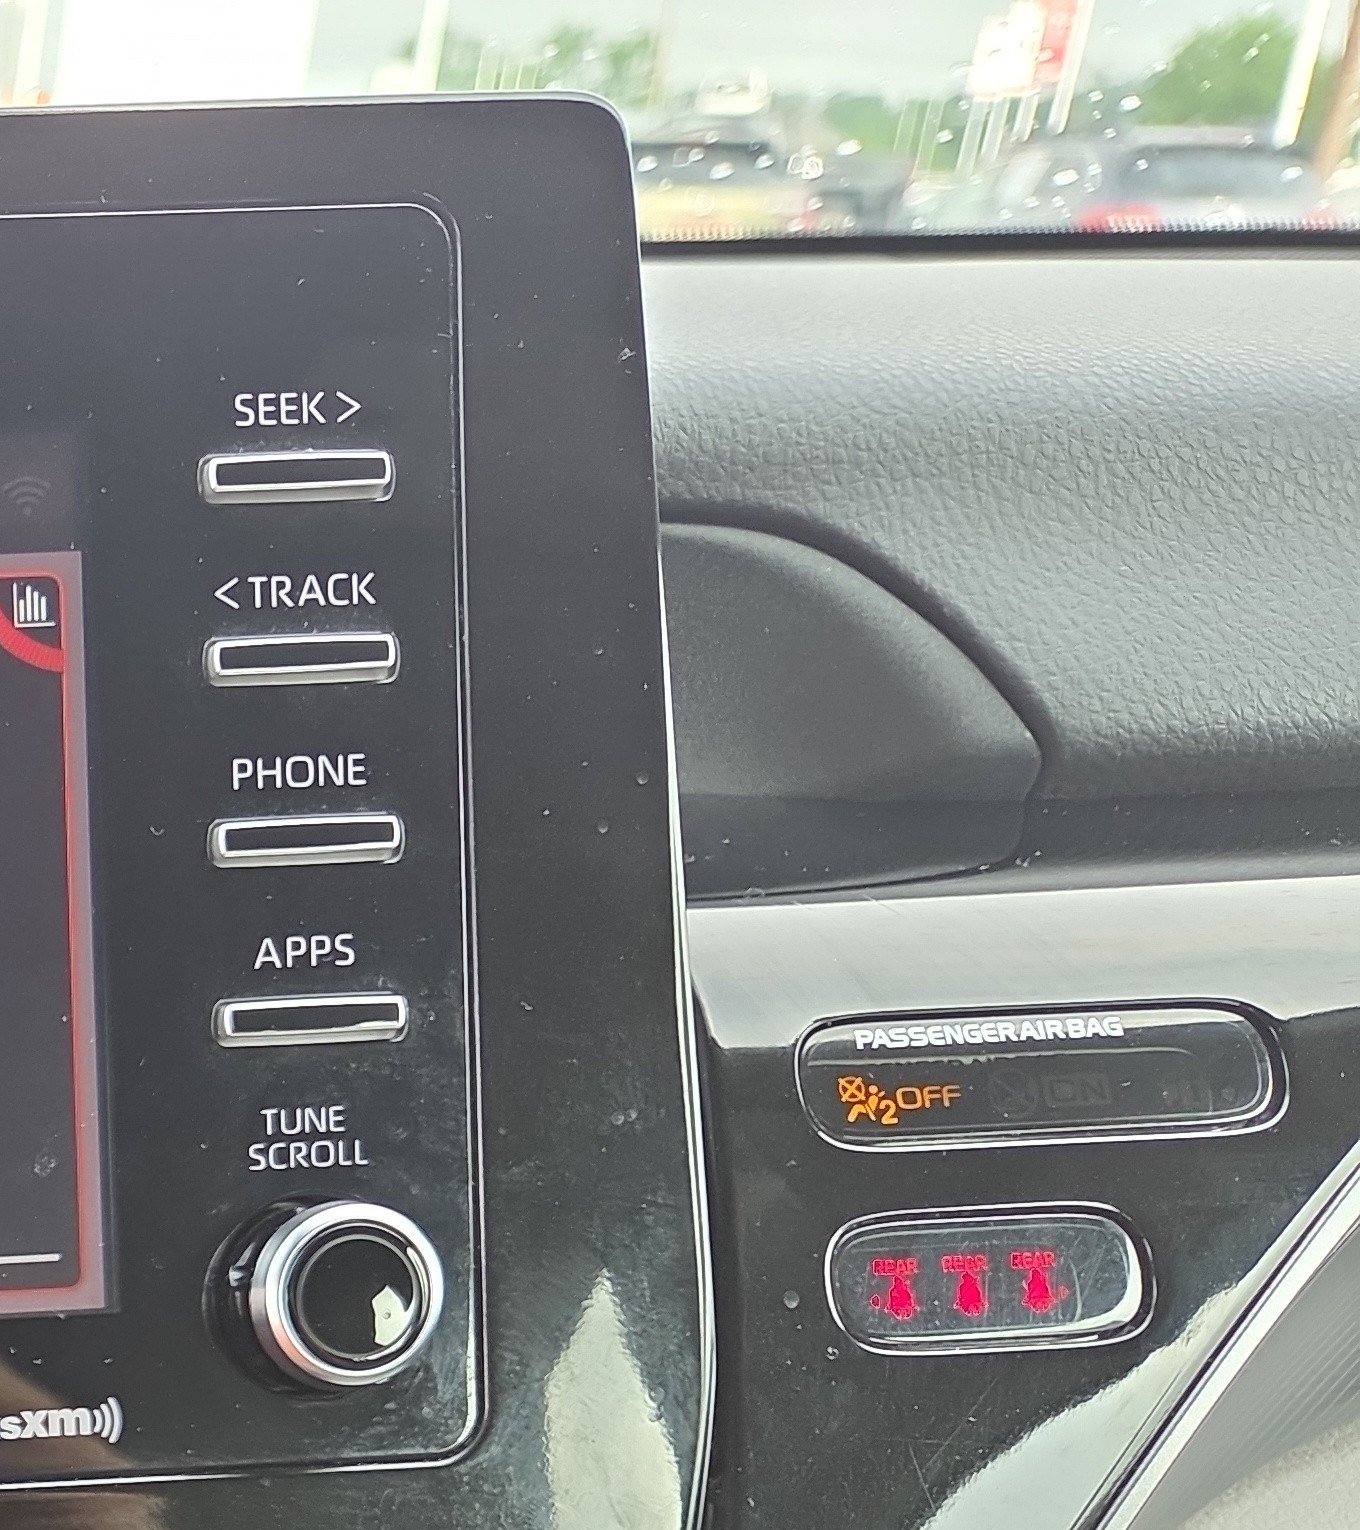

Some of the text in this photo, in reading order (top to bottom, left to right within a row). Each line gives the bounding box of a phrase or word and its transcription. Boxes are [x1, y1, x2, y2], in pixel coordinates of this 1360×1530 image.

[232, 754, 367, 790] PHONE
[254, 934, 355, 969] APPS
[853, 1020, 1019, 1050] PASSENGER
[1067, 1016, 1124, 1038] BAG
[895, 1085, 961, 1110] OFF
[260, 1106, 346, 1136] TUNE
[248, 1140, 369, 1171] SCROLL
